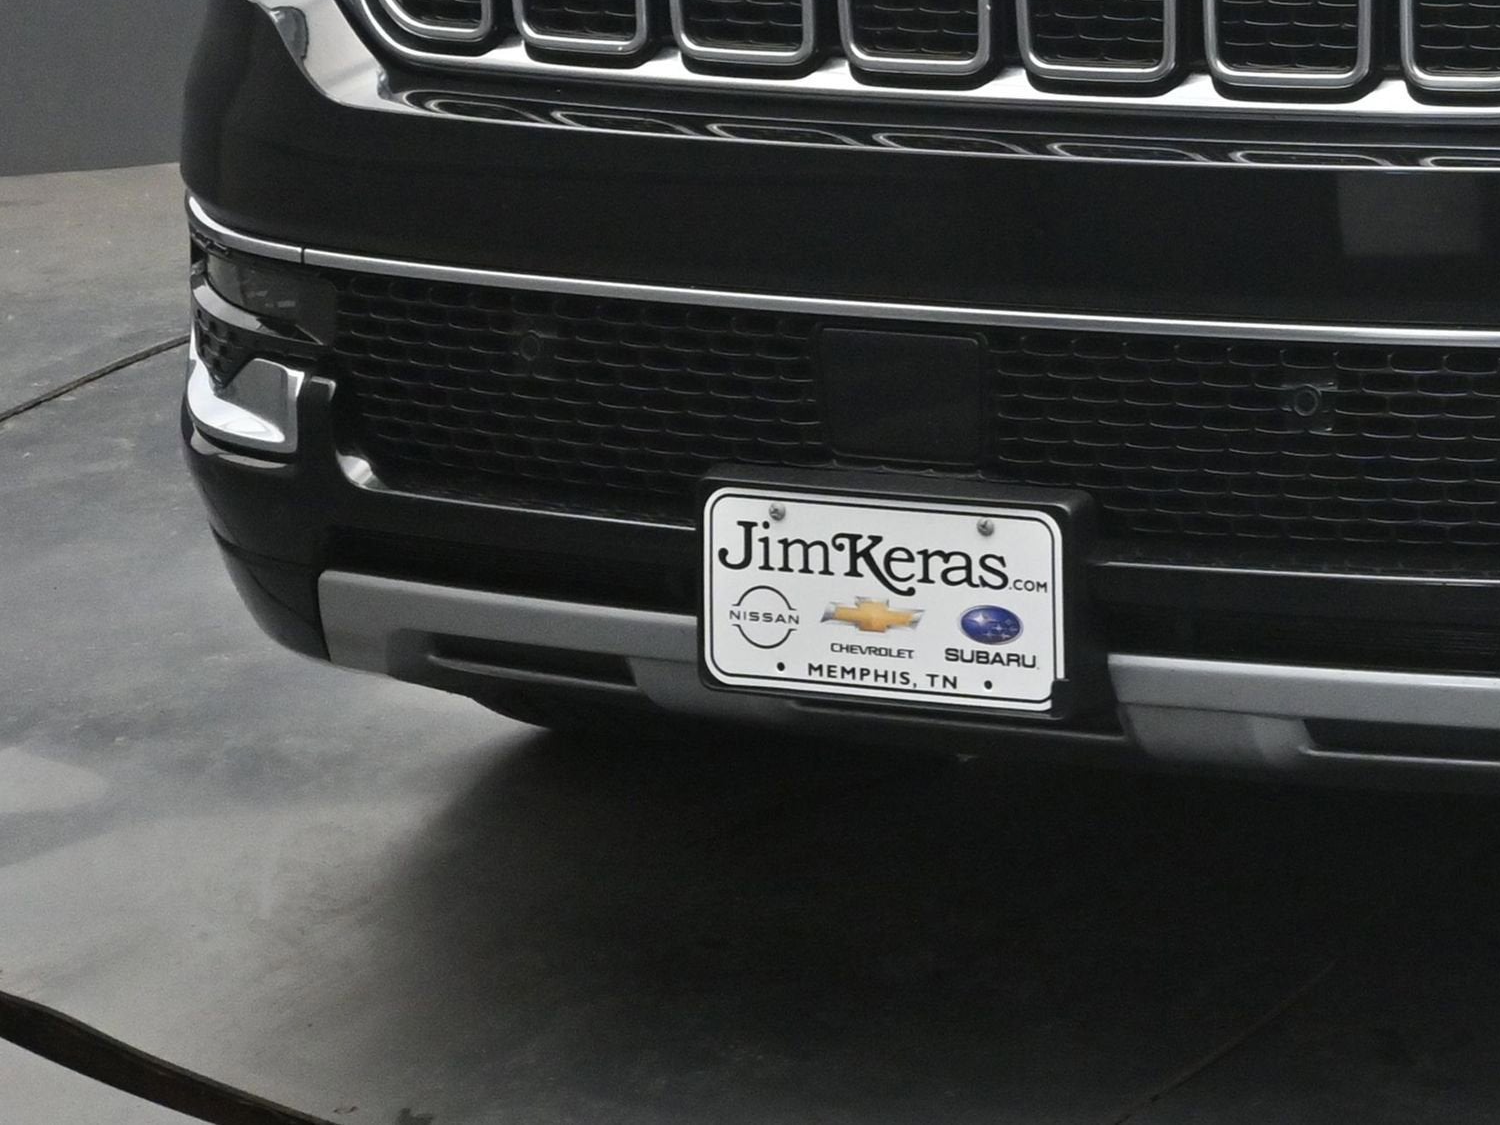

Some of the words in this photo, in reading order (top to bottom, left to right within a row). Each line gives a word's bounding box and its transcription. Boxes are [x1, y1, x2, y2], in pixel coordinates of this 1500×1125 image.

[729, 609, 800, 625] NISSAN
[830, 642, 915, 659] CHEVROLET
[944, 648, 1037, 668] SUBARU
[807, 662, 917, 688] MEMPHIS,
[926, 673, 958, 690] TN
